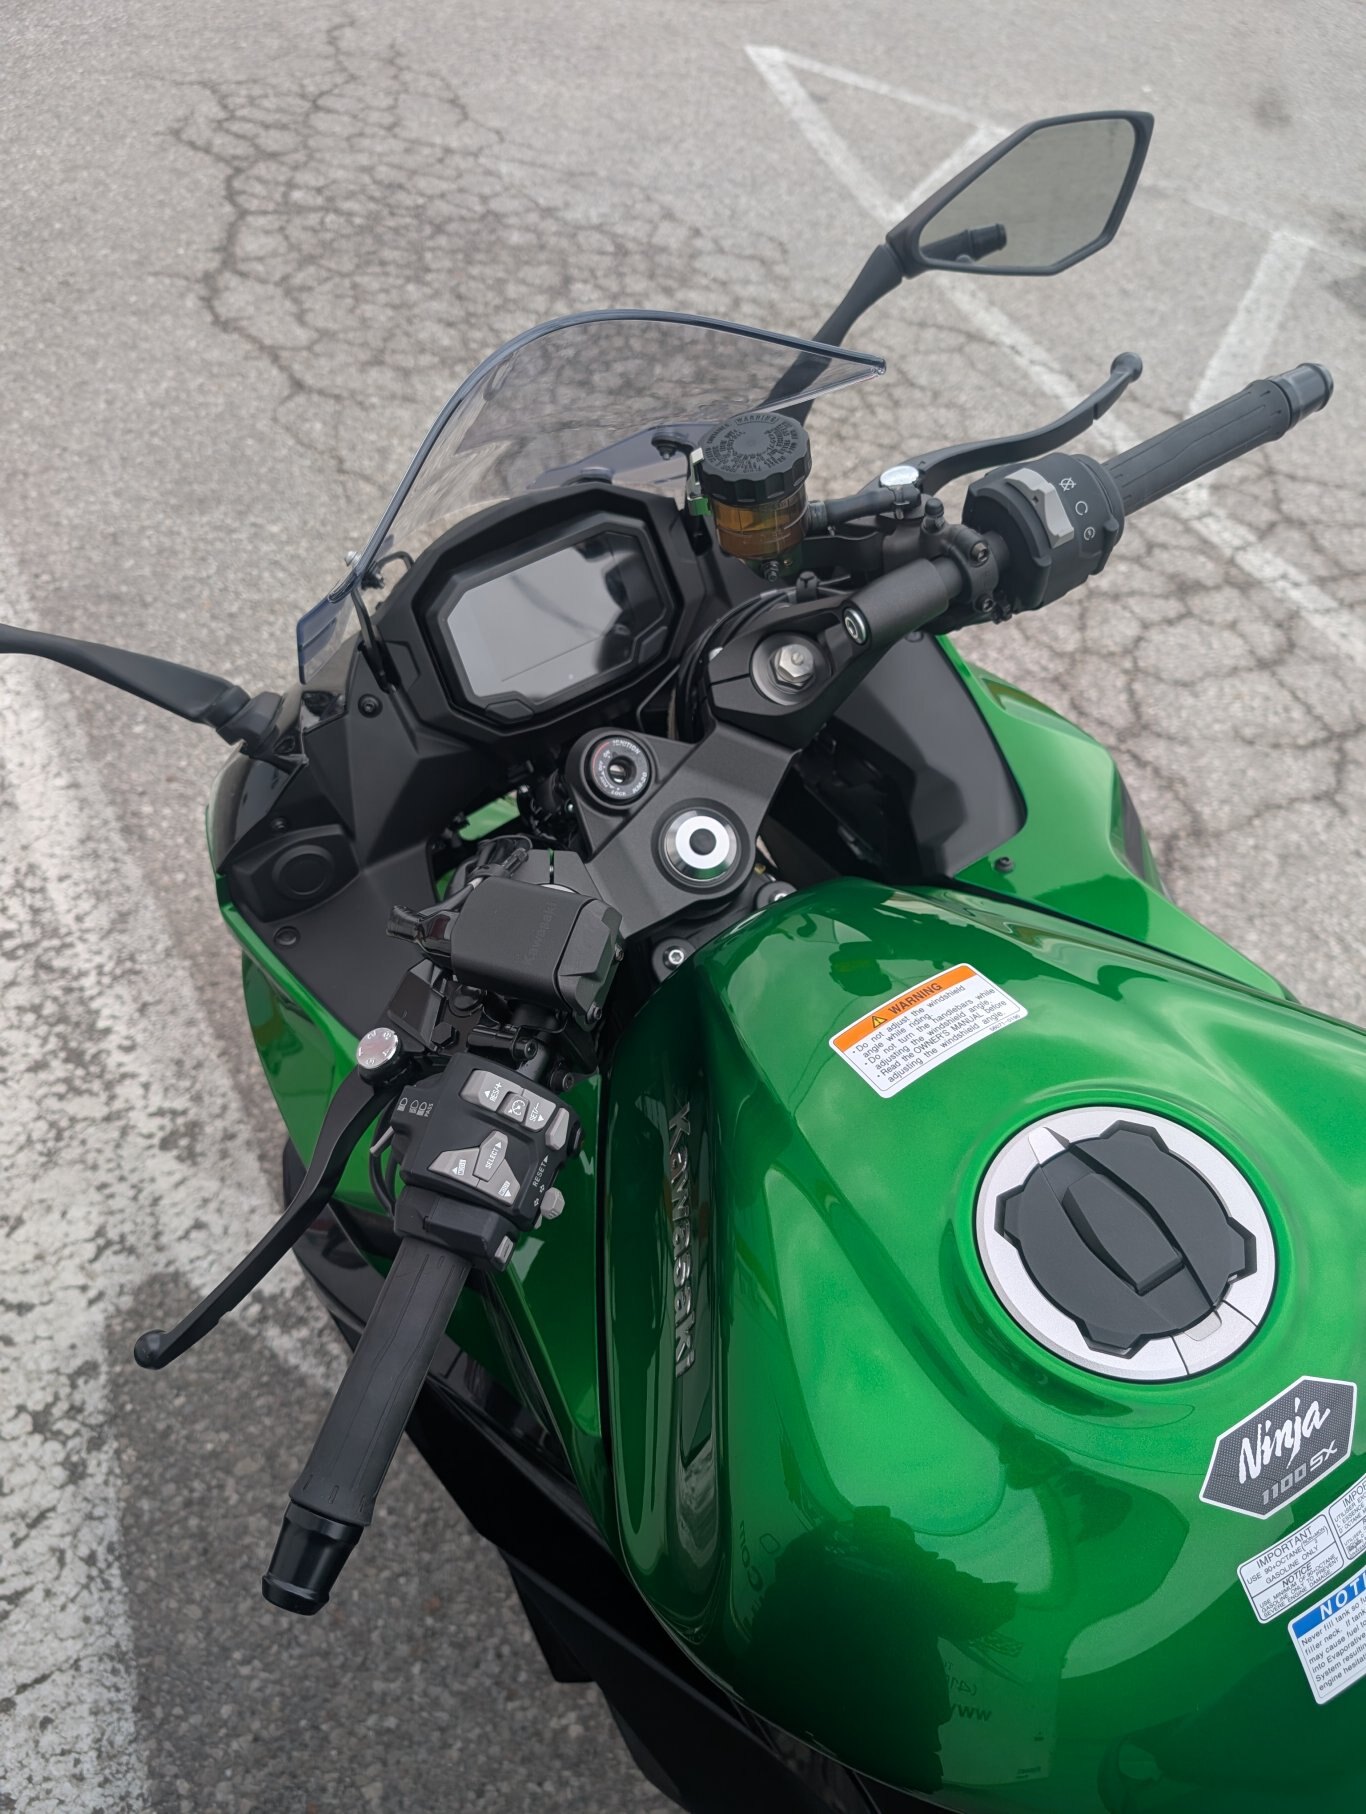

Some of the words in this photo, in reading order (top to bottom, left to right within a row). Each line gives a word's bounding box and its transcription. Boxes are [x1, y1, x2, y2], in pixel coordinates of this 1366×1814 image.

[856, 1042, 869, 1053] Do
[871, 1031, 884, 1043] not
[887, 1016, 910, 1034] adjust
[911, 1007, 925, 1018] the
[927, 984, 966, 1009] windshield
[888, 982, 943, 1015] WARNING
[862, 1040, 884, 1059] angle
[886, 1027, 906, 1043] while
[868, 1054, 881, 1064] Do
[883, 1042, 897, 1054] not
[898, 1031, 915, 1045] turn
[916, 1021, 930, 1033] the
[932, 999, 974, 1023] handlebars
[976, 987, 996, 1000] while
[875, 1045, 911, 1071] adjusting
[912, 1035, 925, 1047] the
[927, 1011, 967, 1036] windshield
[881, 1059, 901, 1077] Read
[902, 1052, 915, 1063] the
[913, 1030, 950, 1055] OWNER'S
[951, 1012, 984, 1032] MANUAL
[984, 999, 1007, 1014] before
[887, 1057, 924, 1083] adjusting
[924, 1047, 938, 1059] the
[940, 1023, 980, 1049] windshield
[485, 1147, 500, 1170] SELECT
[532, 1162, 548, 1187] RESET
[668, 1101, 696, 1379] Kawasaki
[1238, 1397, 1331, 1485] Ninja
[1262, 1463, 1307, 1506] 1100
[1256, 1525, 1313, 1569] IMPORTANT
[1265, 1558, 1299, 1584] GASOLINE
[1301, 1544, 1319, 1560] ONLY
[1246, 1572, 1263, 1585] USE
[1282, 1561, 1313, 1588] NOTICE
[1301, 1629, 1323, 1646] Never
[1323, 1620, 1335, 1631] fill
[1335, 1608, 1351, 1623] tank
[1351, 1602, 1360, 1612] so
[1308, 1652, 1325, 1666] may
[1325, 1636, 1346, 1654] cause
[1346, 1623, 1360, 1638] fuel
[1304, 1641, 1324, 1656] filler
[1311, 1661, 1326, 1674] into
[1327, 1632, 1366, 1663] Evaporative
[1315, 1662, 1342, 1683] System
[1319, 1671, 1343, 1691] engine
